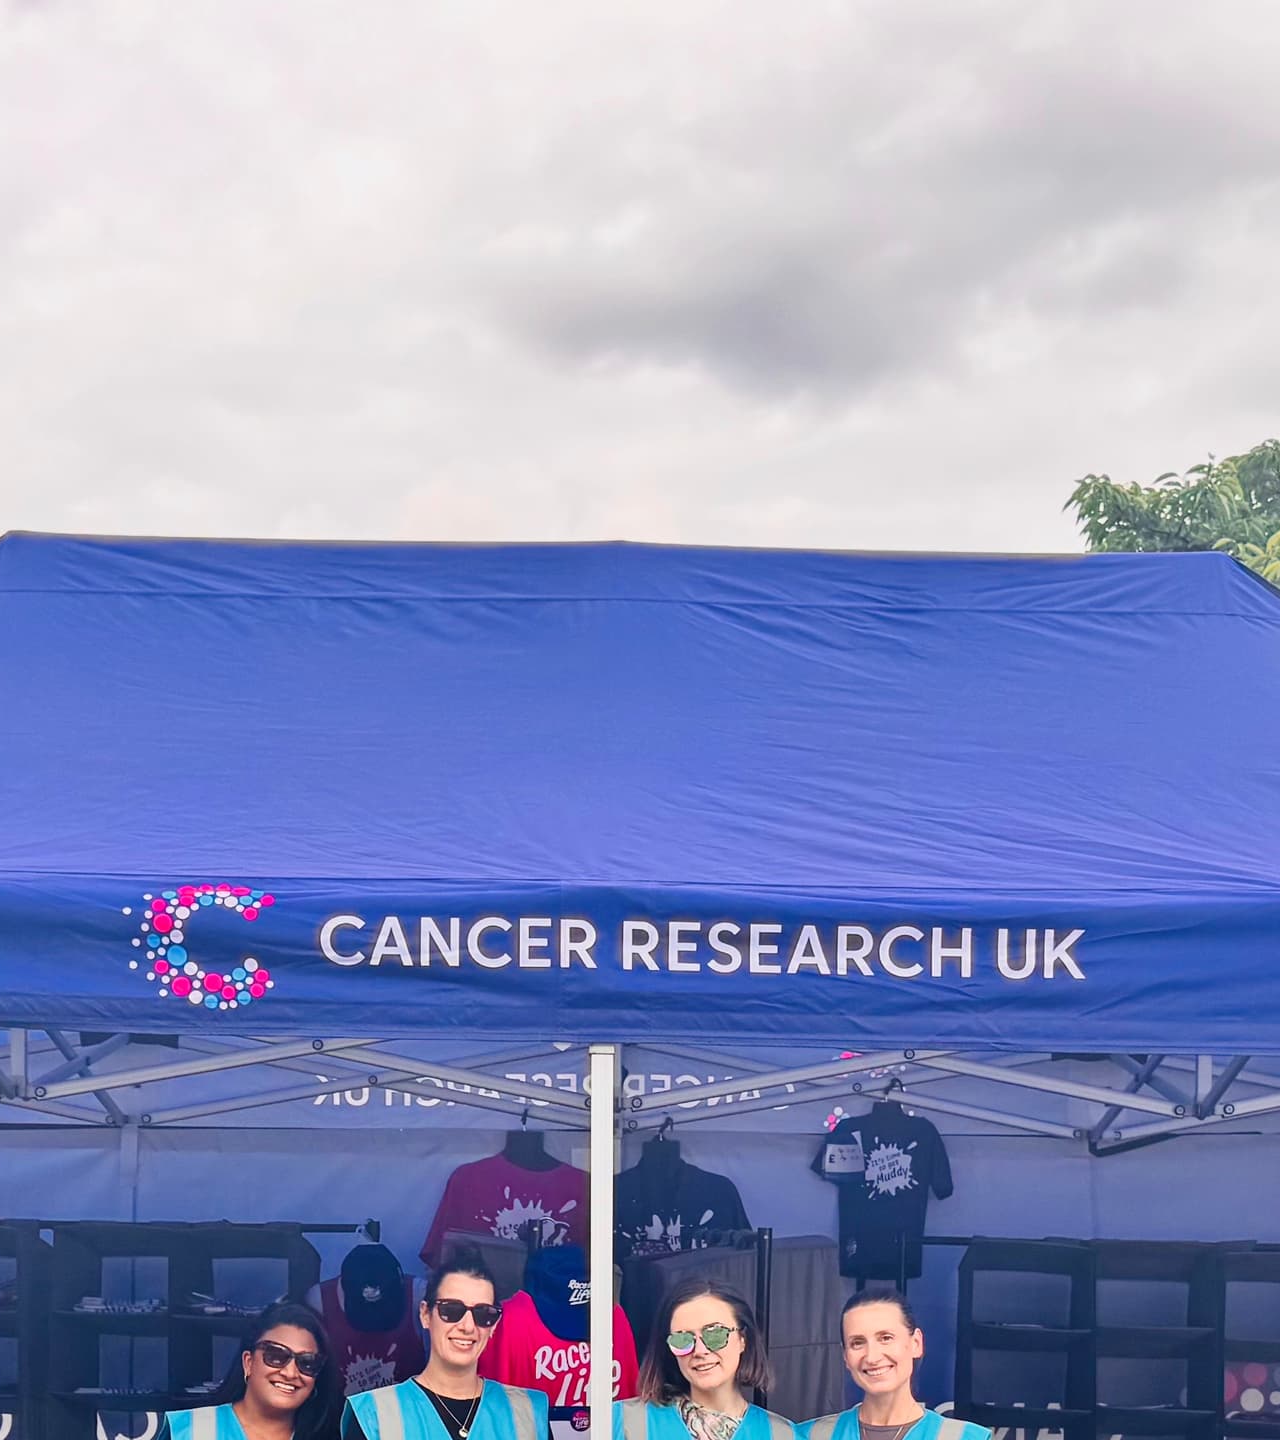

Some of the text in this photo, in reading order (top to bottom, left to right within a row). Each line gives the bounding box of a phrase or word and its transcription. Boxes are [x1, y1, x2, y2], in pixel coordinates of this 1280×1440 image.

[319, 914, 1087, 981] CANCER RESEARCH UK
[876, 1167, 909, 1186] Muddy
[534, 1342, 592, 1381] Race
